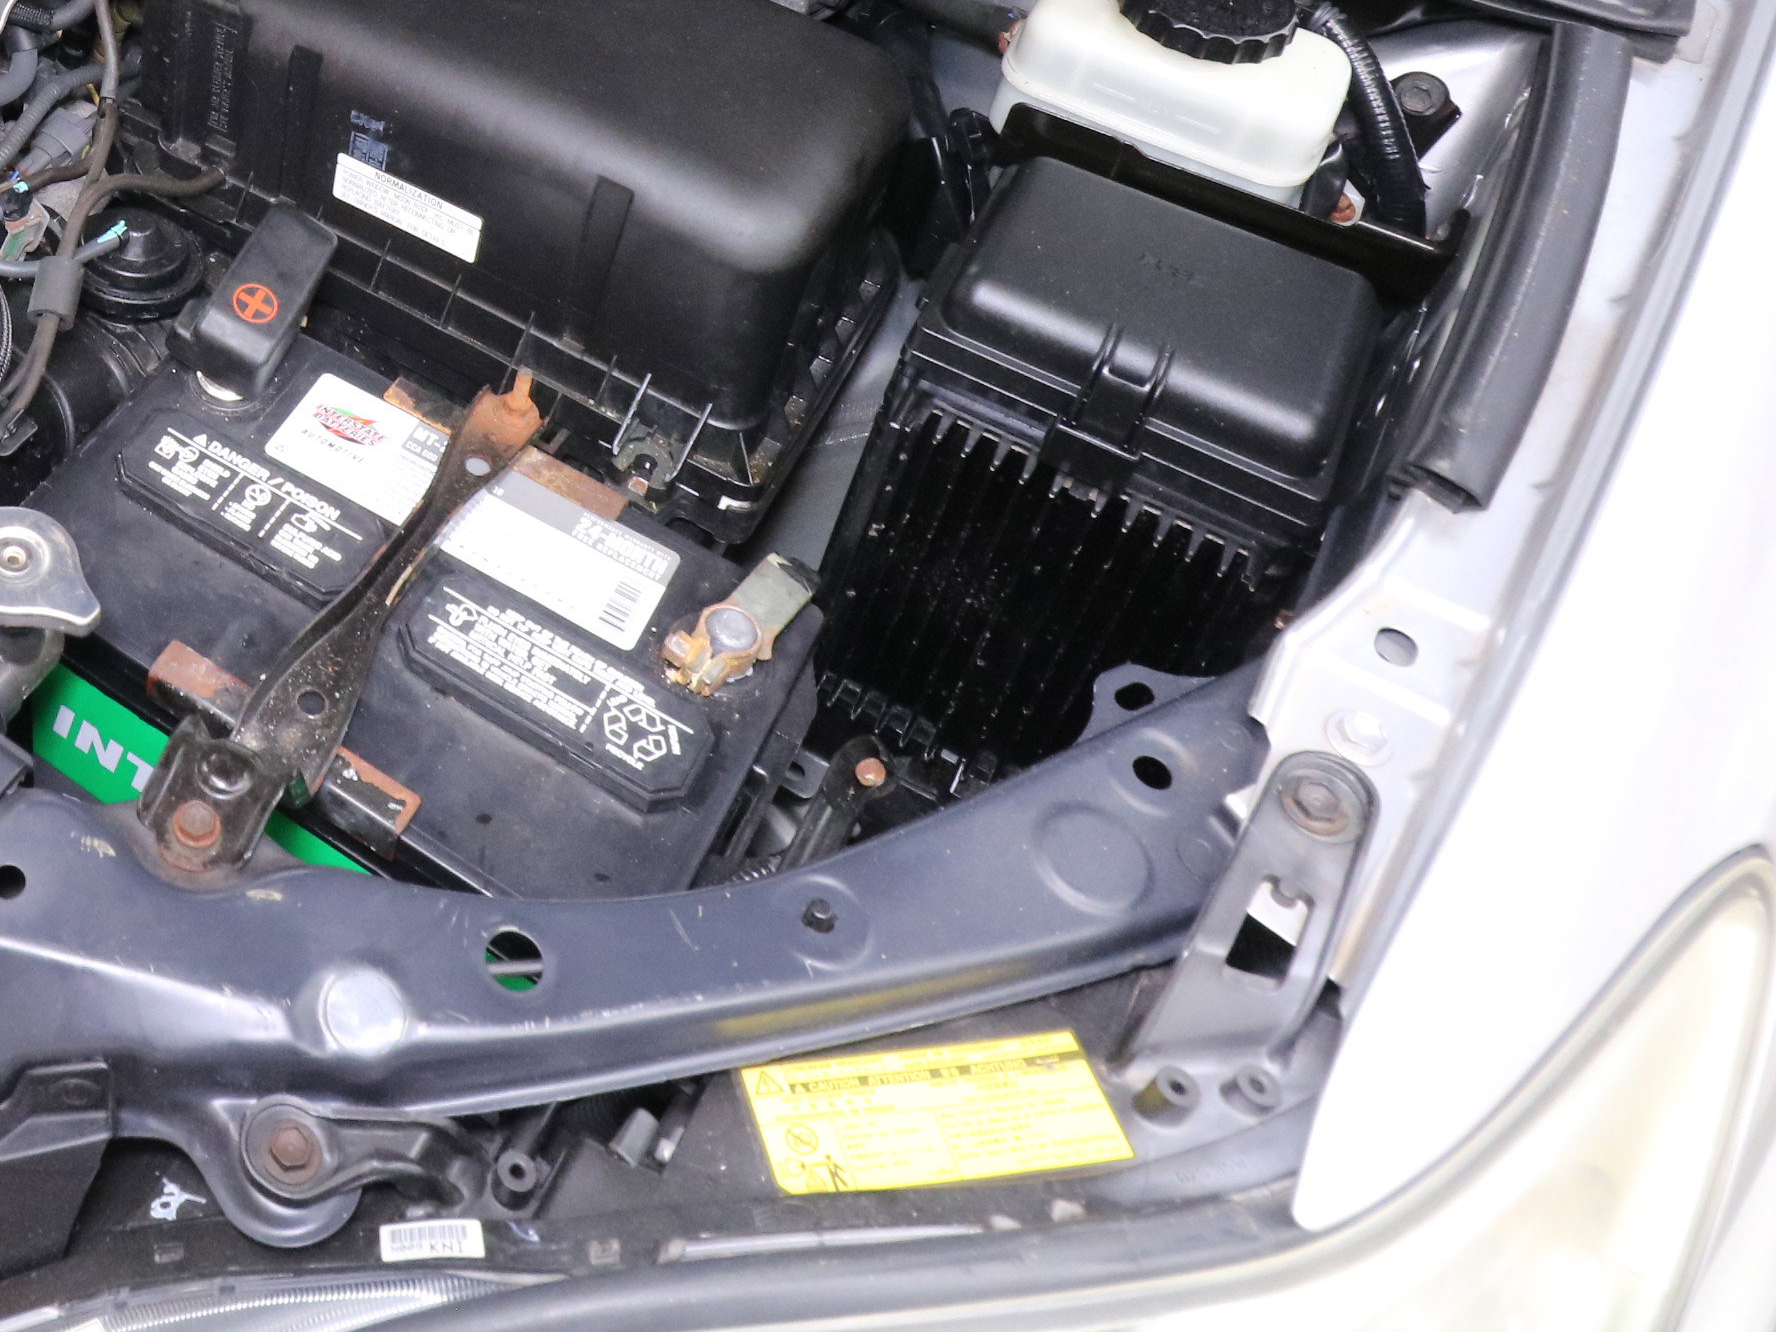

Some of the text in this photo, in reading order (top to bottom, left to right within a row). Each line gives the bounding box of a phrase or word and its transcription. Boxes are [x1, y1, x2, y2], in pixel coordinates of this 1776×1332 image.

[375, 171, 443, 209] NORMALIZATION
[313, 412, 376, 446] BATTERIES
[317, 404, 388, 442] INTERSTATE
[301, 429, 367, 463] AUTOMOTIVE
[209, 440, 271, 482] DANGER
[281, 481, 341, 521] POISON
[575, 517, 669, 575] 24-MONTH
[808, 1077, 860, 1093] CAUTION
[867, 1070, 931, 1086] ATTENTION
